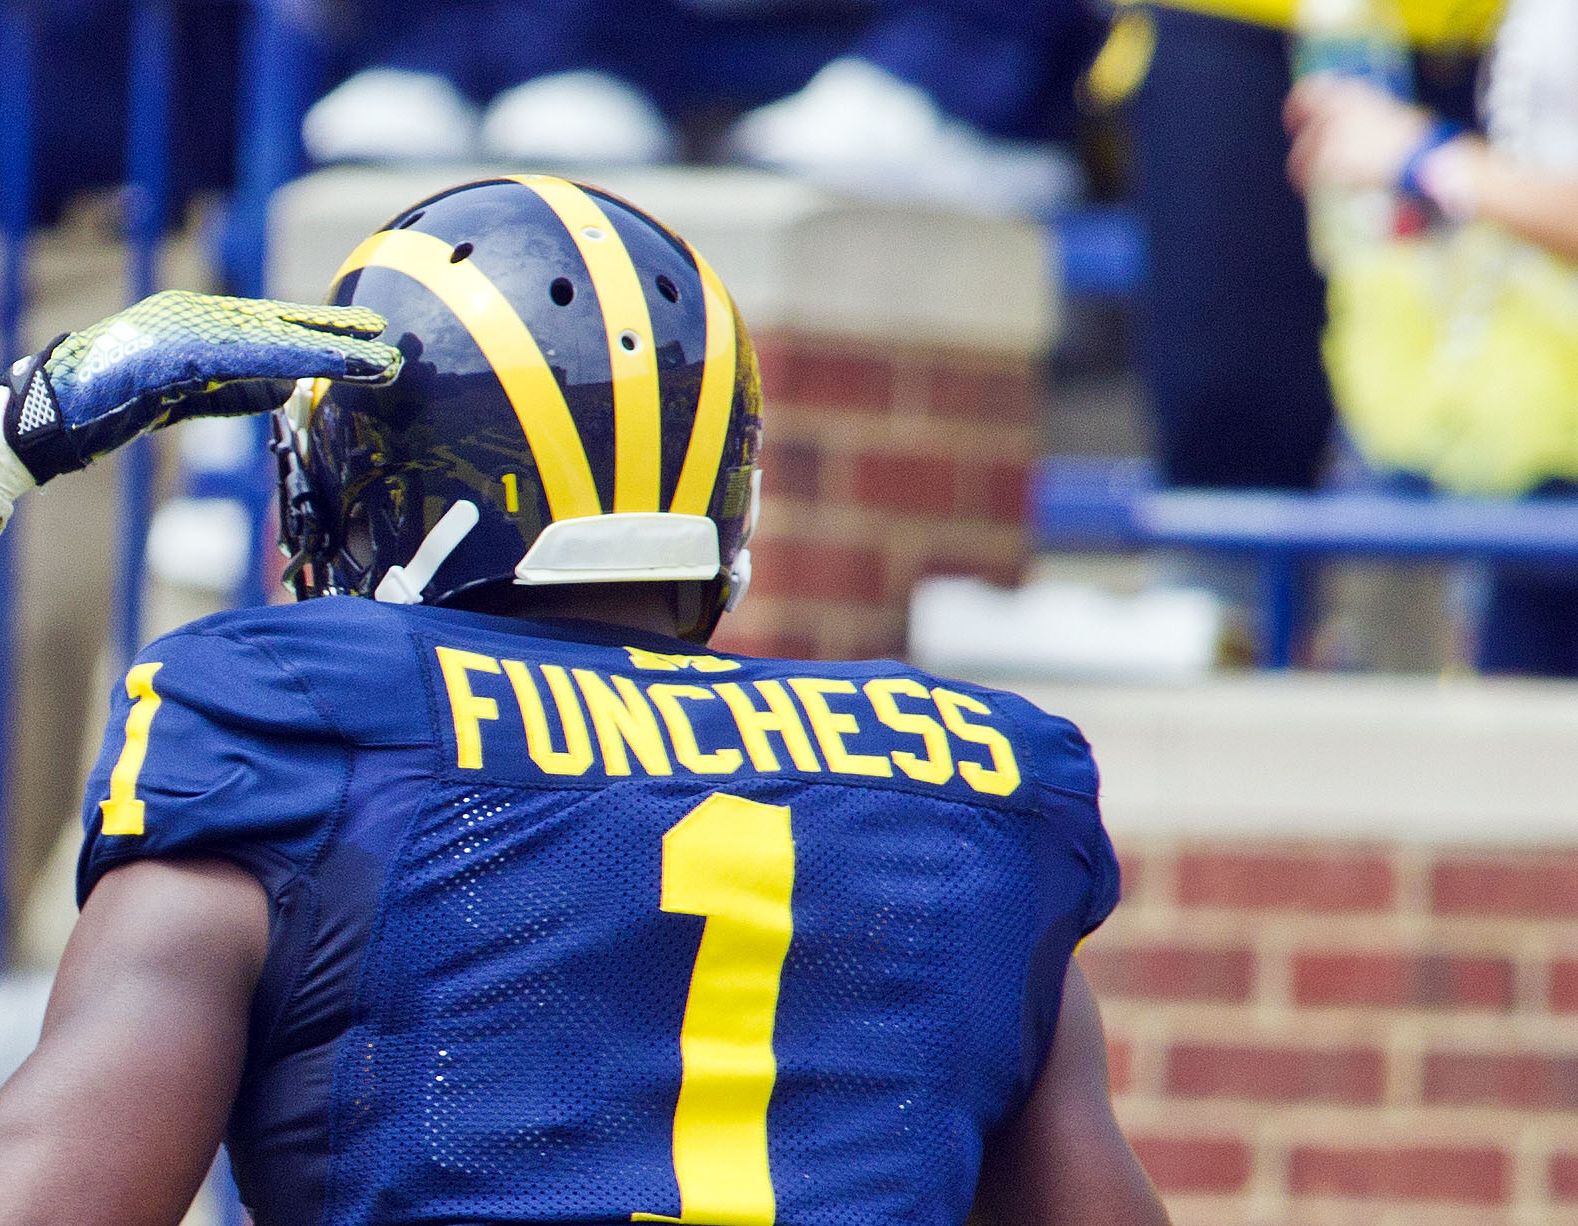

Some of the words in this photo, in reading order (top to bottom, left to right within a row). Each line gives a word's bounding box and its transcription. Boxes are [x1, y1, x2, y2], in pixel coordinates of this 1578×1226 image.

[78, 334, 154, 383] adidas
[502, 473, 519, 512] 1
[99, 662, 163, 835] 1
[435, 646, 1021, 797] FUNCHESS
